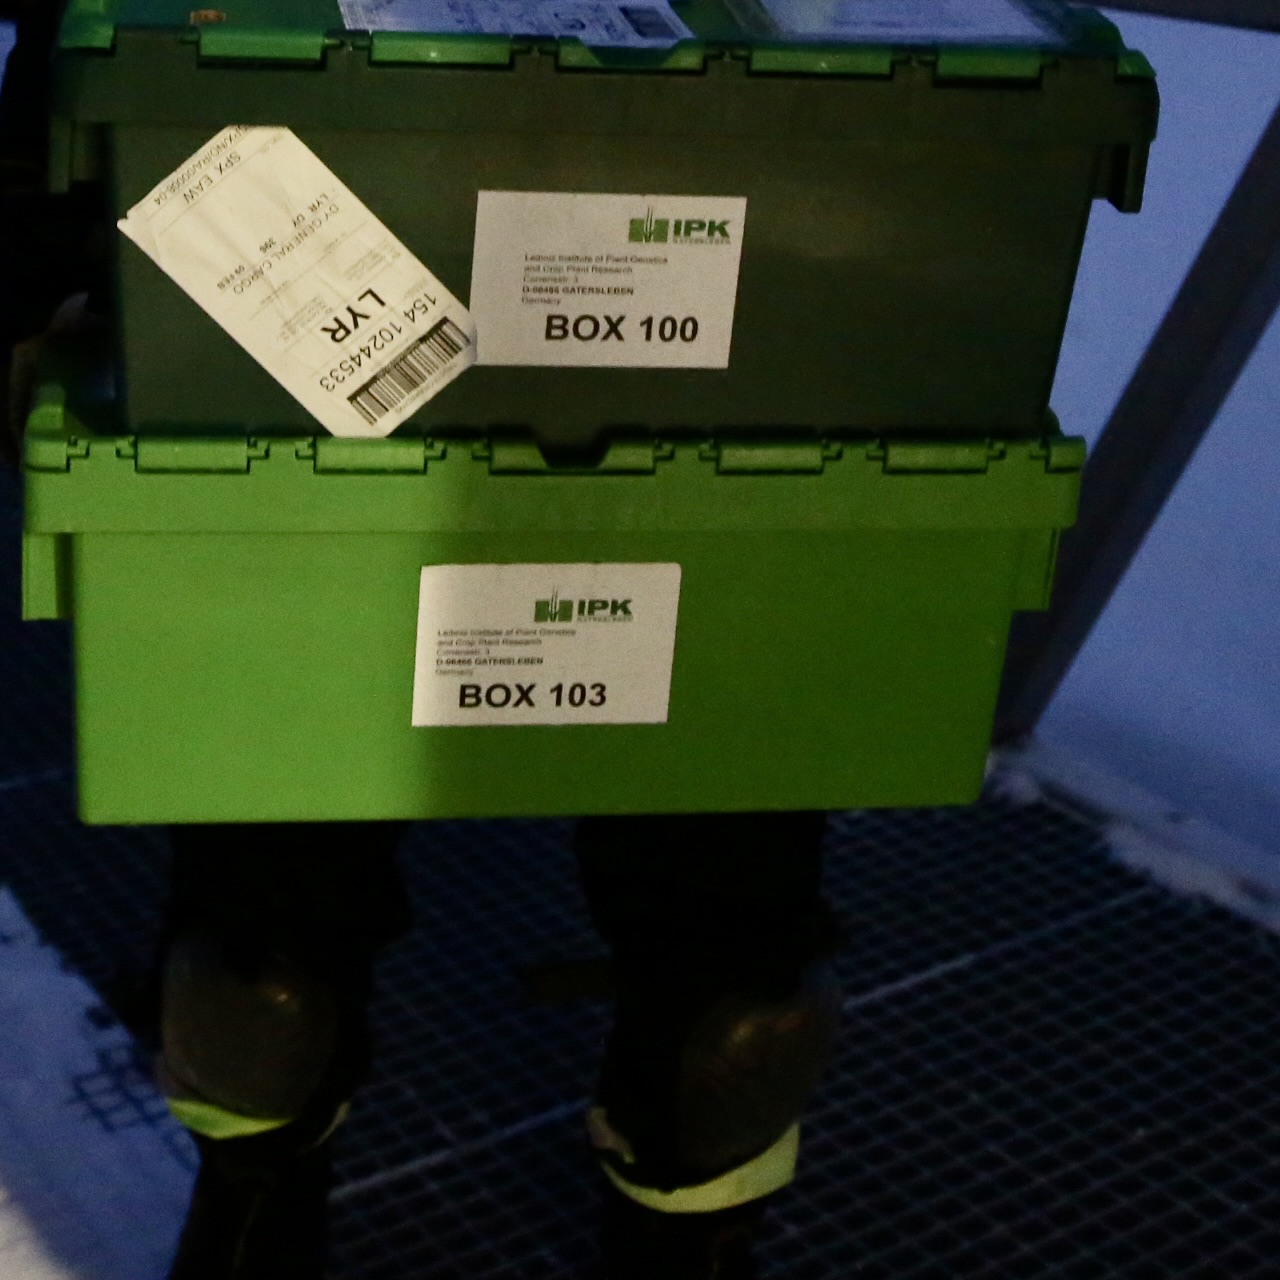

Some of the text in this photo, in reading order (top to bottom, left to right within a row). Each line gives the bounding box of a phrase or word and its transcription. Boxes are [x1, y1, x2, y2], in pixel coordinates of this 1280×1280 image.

[270, 217, 325, 263] GENERAL
[674, 219, 731, 237] IPK
[232, 258, 273, 295] CARGO
[321, 288, 387, 344] LYR
[402, 292, 438, 323] 154
[545, 314, 699, 342] BOX 100
[319, 319, 403, 392] 10244533
[578, 599, 632, 615] IPK
[459, 682, 606, 708] BOX 103
